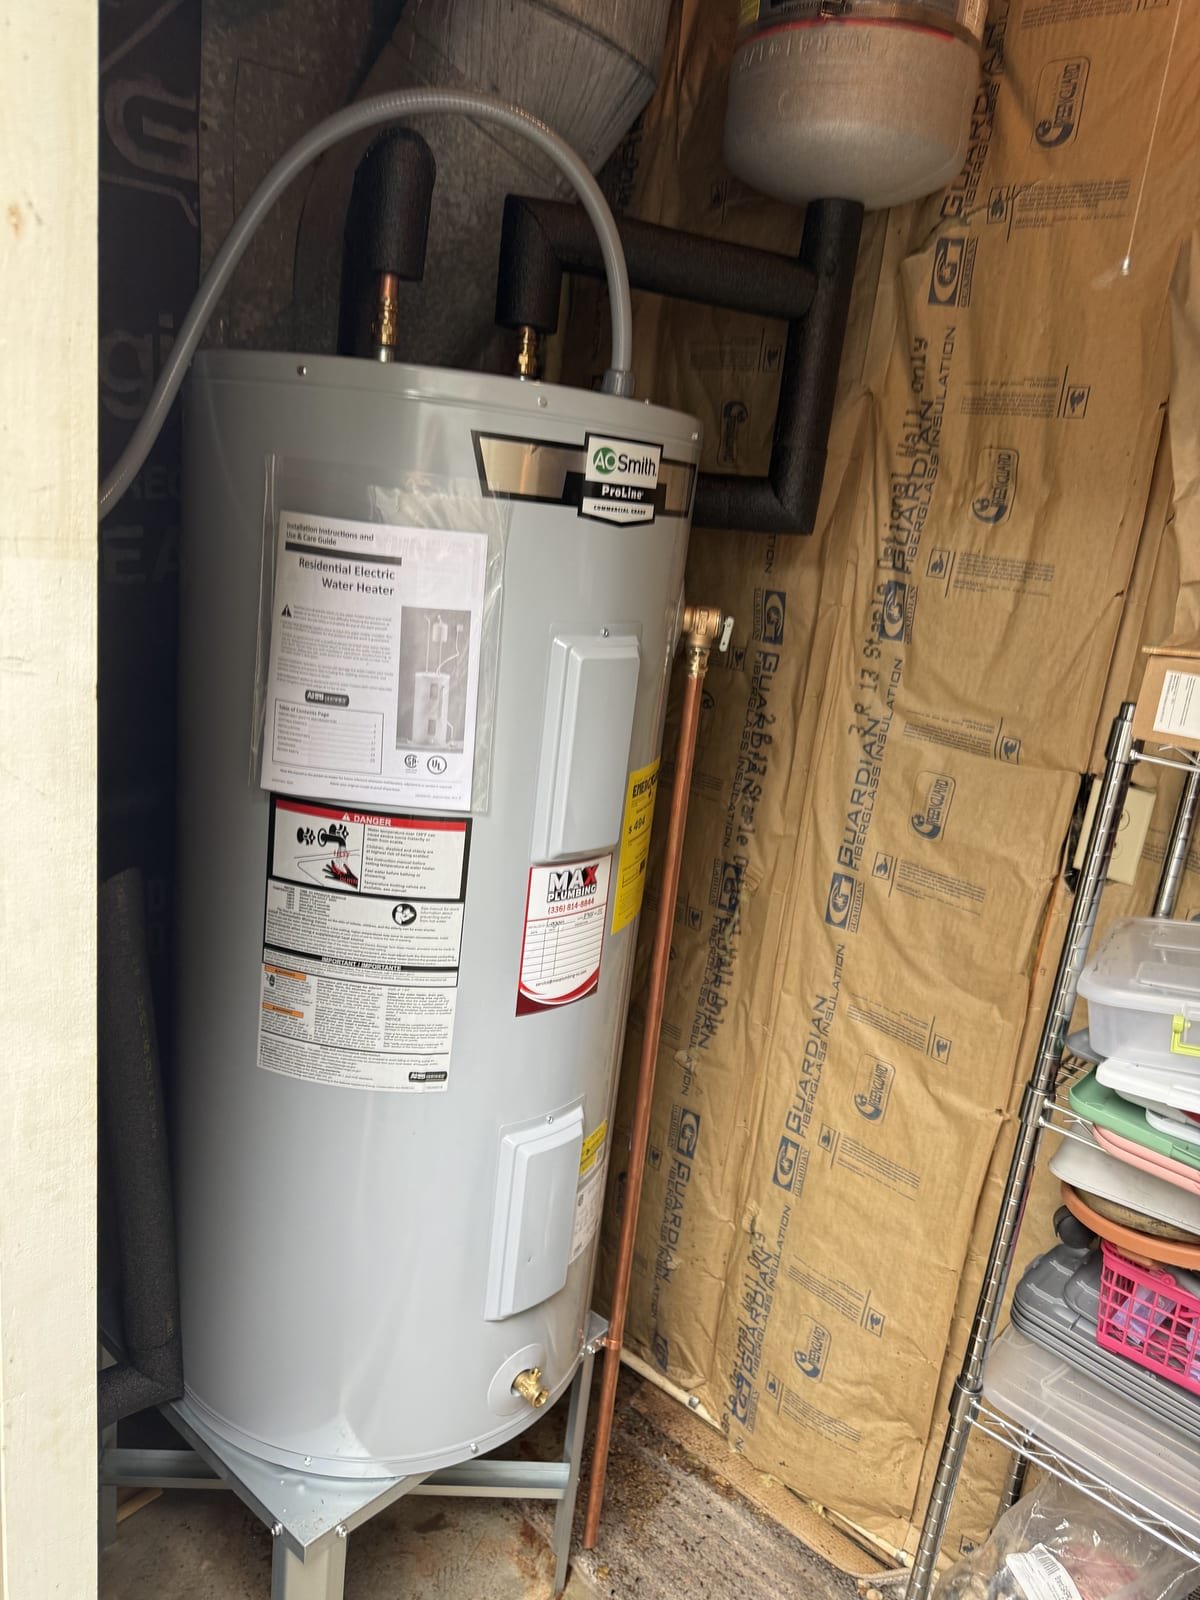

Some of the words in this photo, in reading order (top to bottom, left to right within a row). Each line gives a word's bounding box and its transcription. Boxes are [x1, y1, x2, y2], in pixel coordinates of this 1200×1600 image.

[930, 327, 956, 448] INSULATION
[601, 484, 642, 500] ProLine
[286, 523, 318, 535] Installation
[318, 526, 358, 540] Instructions
[359, 533, 374, 542] and
[303, 534, 317, 543] Care
[317, 537, 337, 546] Guide
[298, 558, 351, 575] Residential
[354, 566, 395, 580] Electric
[322, 577, 353, 592] Water
[356, 582, 395, 597] Heater
[858, 668, 880, 693] 13
[849, 766, 882, 871] FIBERGLASS
[873, 658, 903, 762] INSULATION
[836, 718, 880, 869] GUARDIAN
[353, 815, 392, 827] DANGER
[548, 864, 599, 893] MAX
[547, 884, 597, 903] PLUMBING
[849, 881, 865, 933] GUARDIAN
[548, 905, 565, 914] (336)
[797, 1040, 829, 1138] FIBERGLASS
[819, 944, 846, 1037] INSULATION
[784, 995, 827, 1134] GUARDIAN
[793, 1149, 810, 1198] GUARDIAN
[767, 1205, 792, 1291] INSULATION
[741, 1251, 772, 1374] GUARDIAN
